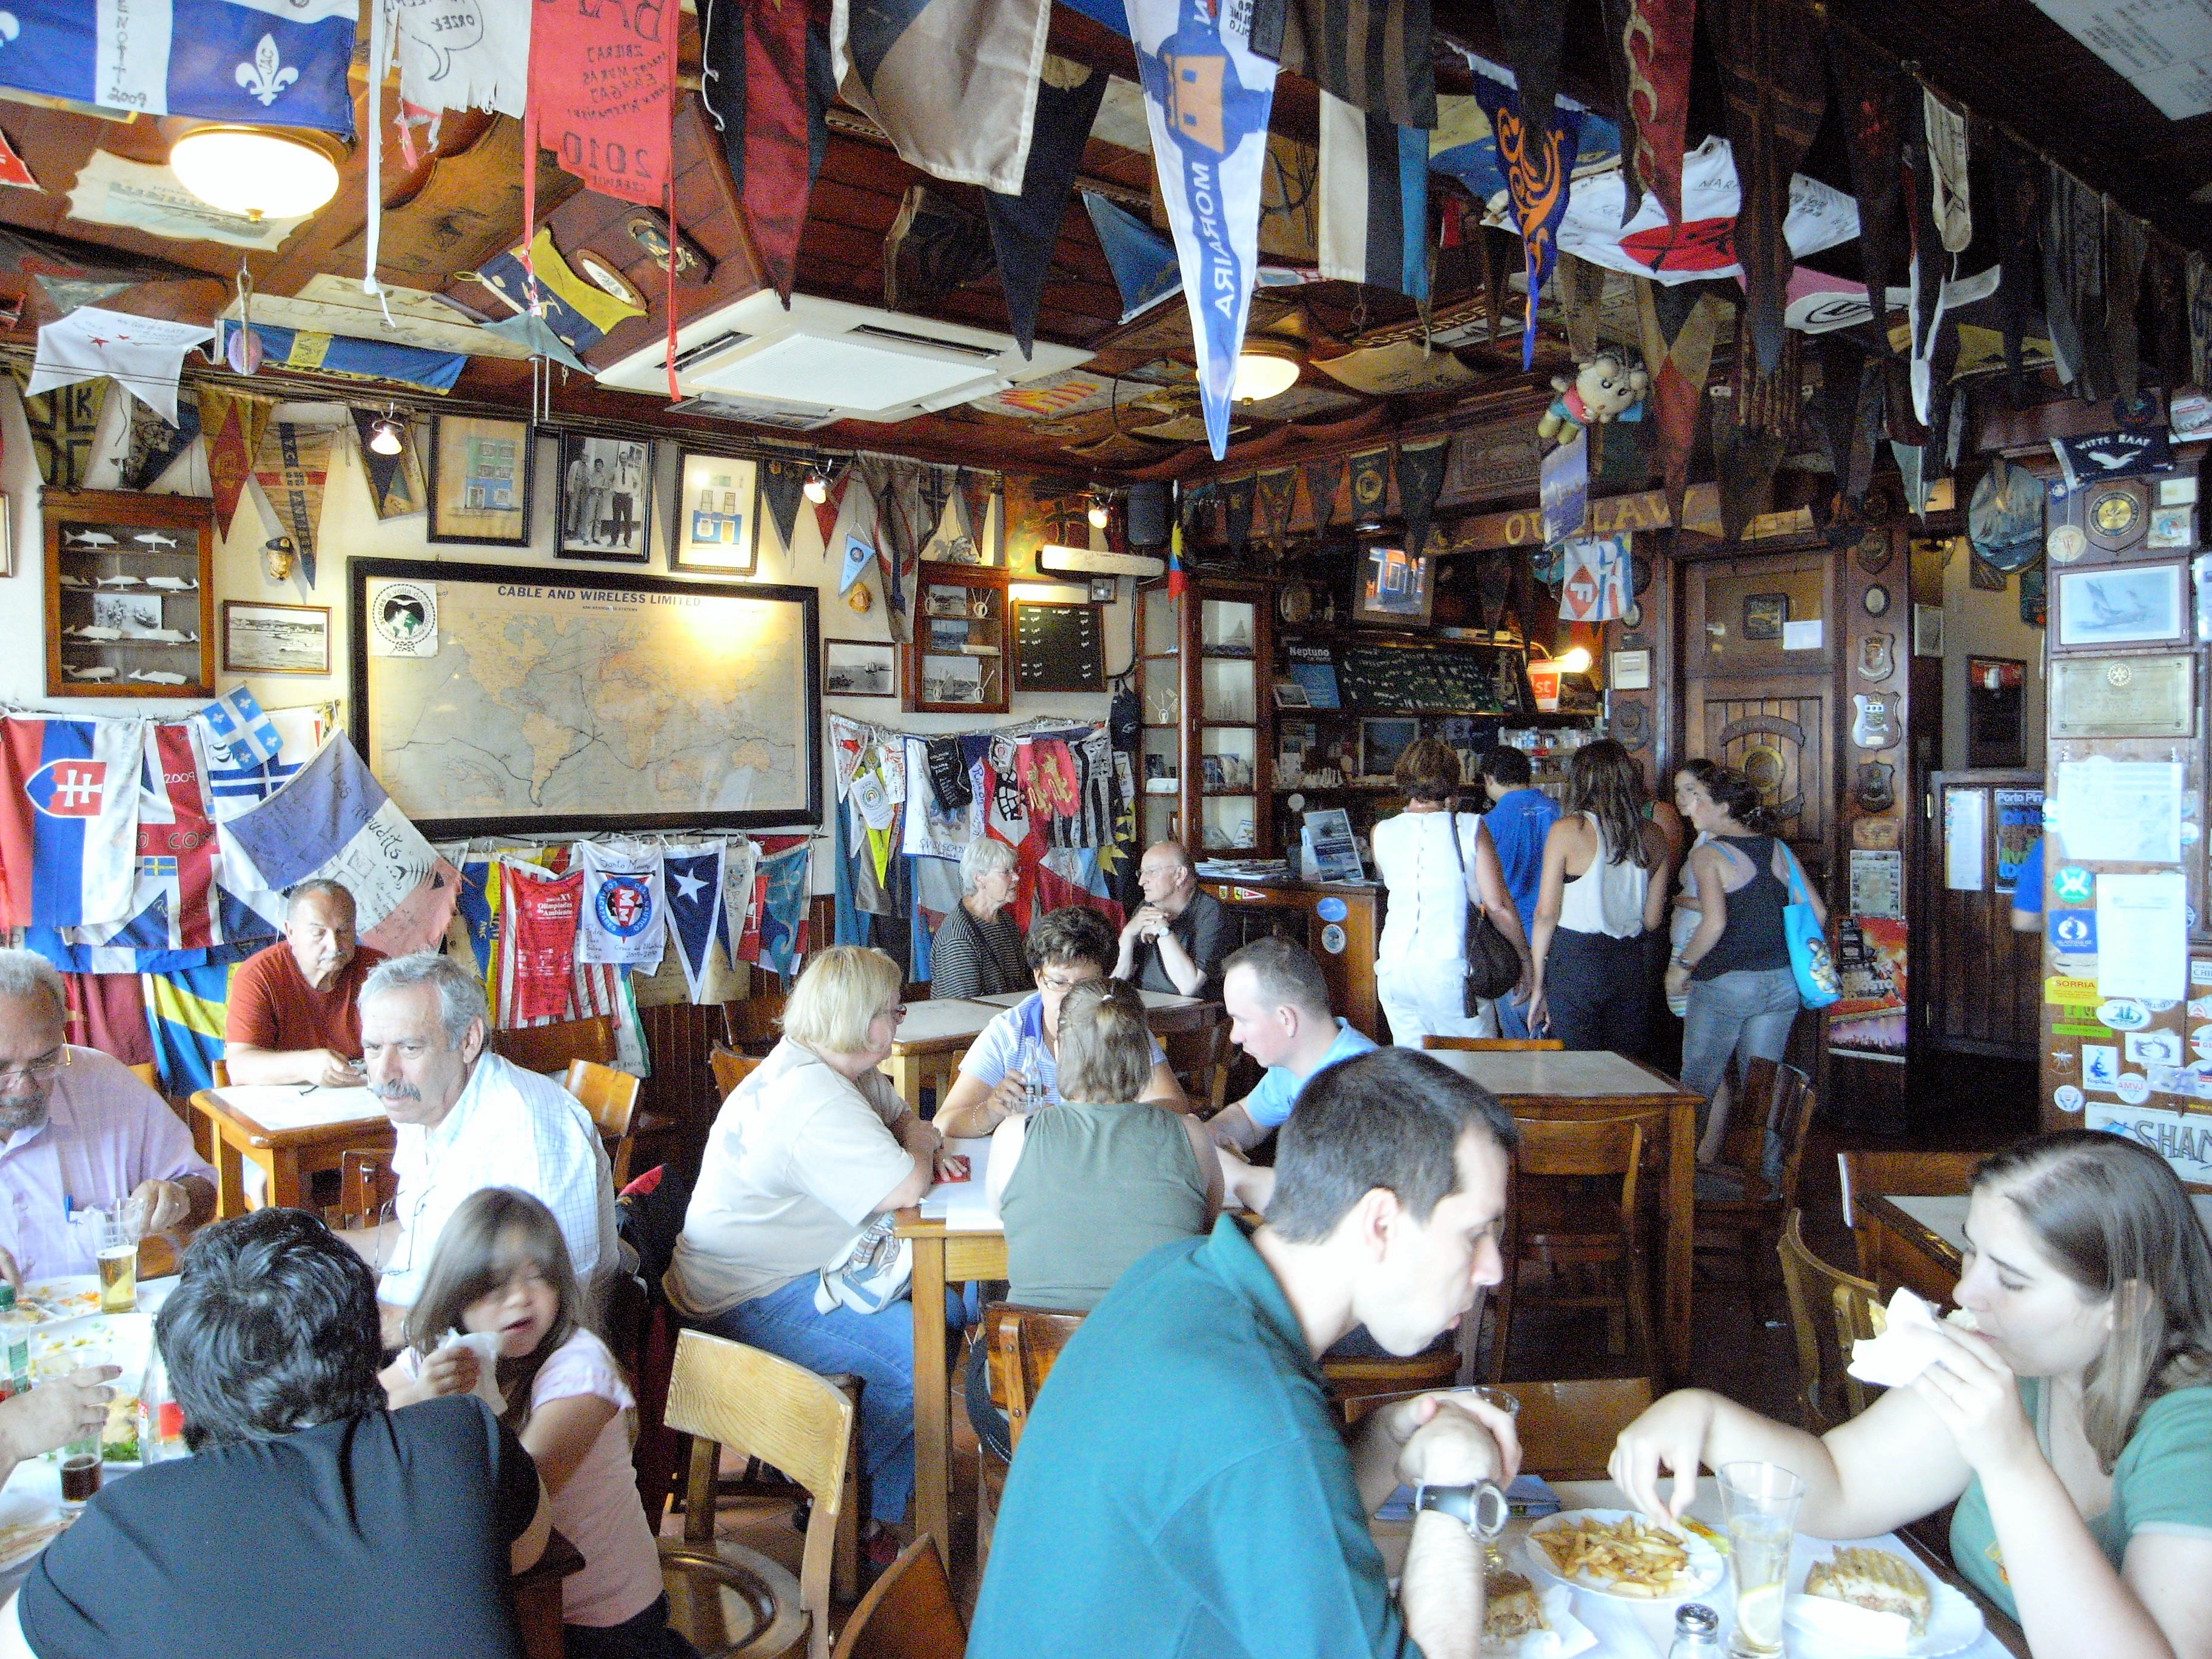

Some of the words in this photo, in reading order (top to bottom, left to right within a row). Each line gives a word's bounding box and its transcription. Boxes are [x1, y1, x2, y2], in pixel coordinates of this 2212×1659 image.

[107, 87, 147, 108] 2009
[2074, 436, 2110, 451] WITTE
[2118, 434, 2151, 446] RAAF
[498, 585, 542, 598] CABLE
[547, 589, 575, 600] AND
[580, 591, 646, 603] WIRELESS
[650, 594, 701, 606] LIMITED
[422, 601, 431, 628] mundo
[1289, 646, 1330, 658] Neptuno
[164, 771, 196, 785] 2009
[1998, 792, 2023, 802] Porto
[2056, 980, 2095, 988] SORRIA
